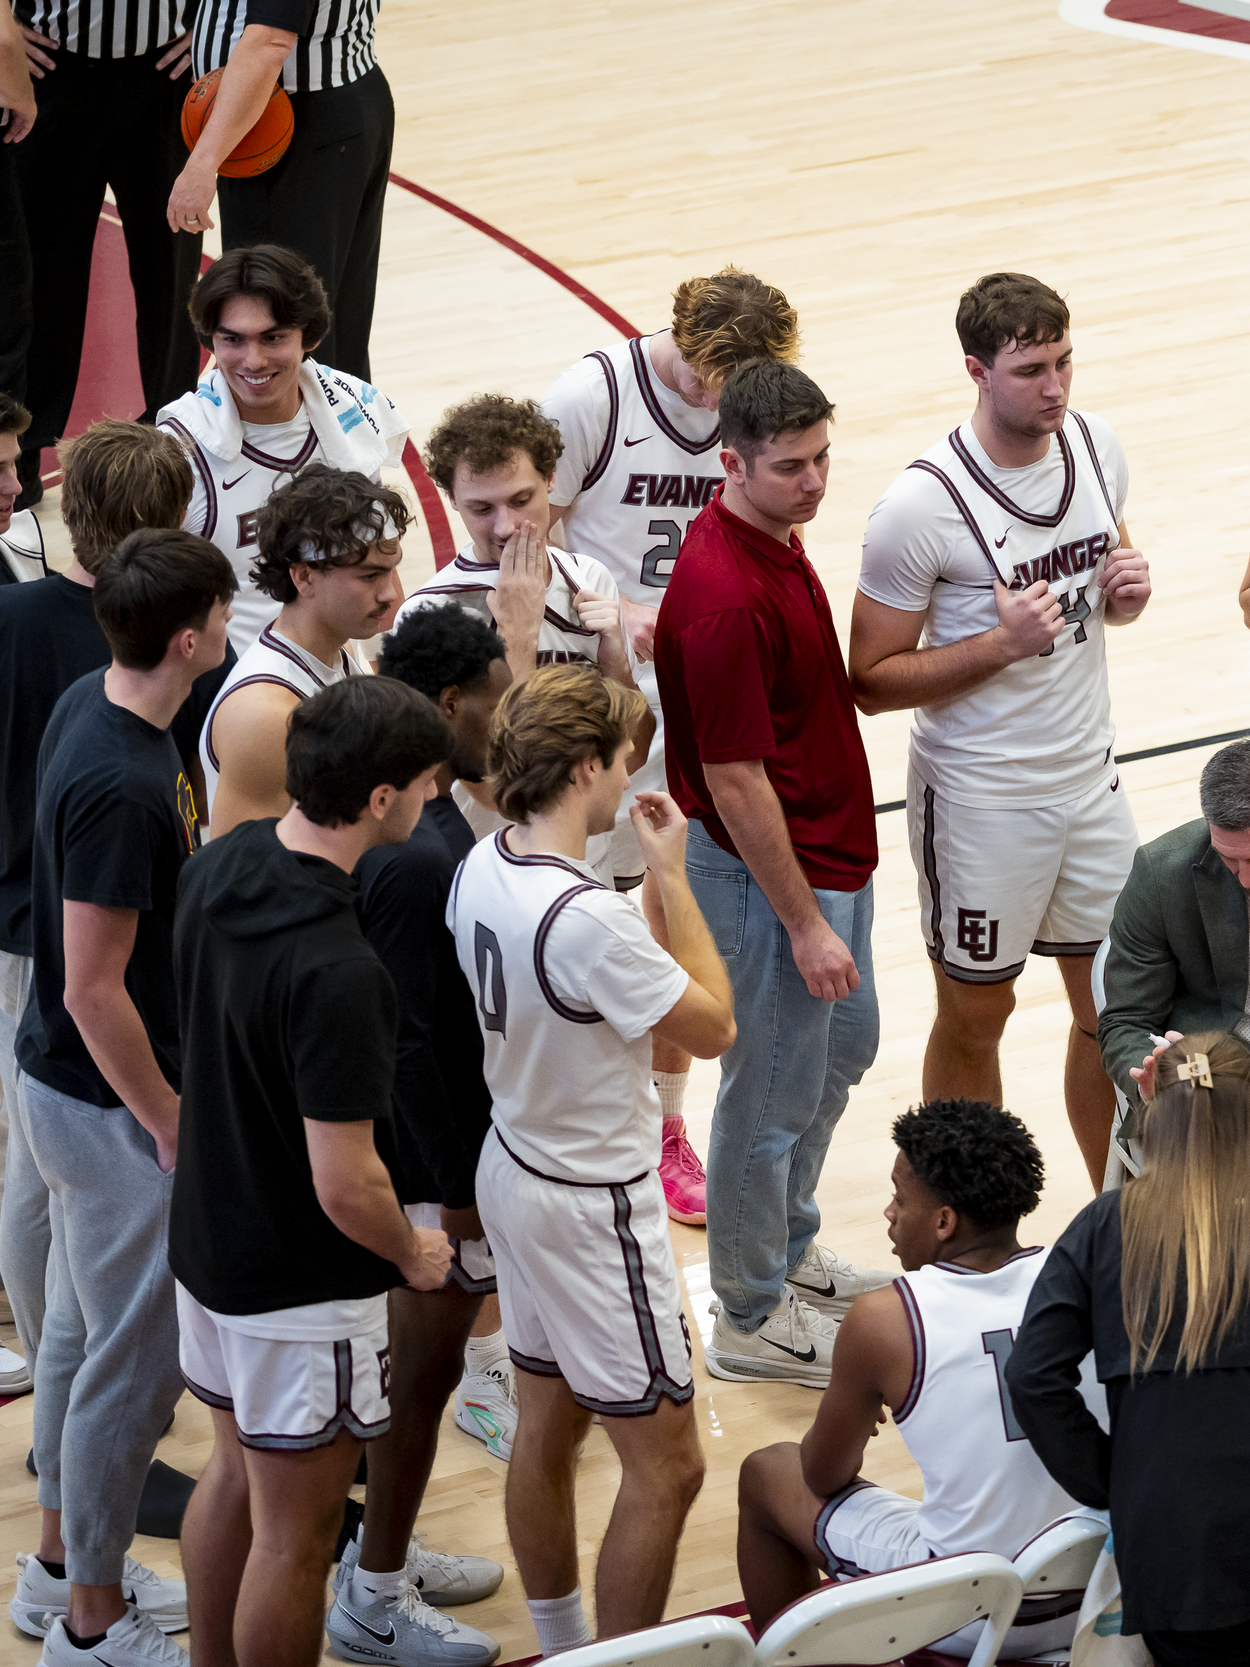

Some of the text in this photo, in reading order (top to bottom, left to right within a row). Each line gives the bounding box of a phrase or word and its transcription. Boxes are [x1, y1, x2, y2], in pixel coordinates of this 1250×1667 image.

[639, 519, 696, 589] 2
[957, 906, 1000, 963] EU
[474, 920, 507, 1041] 0
